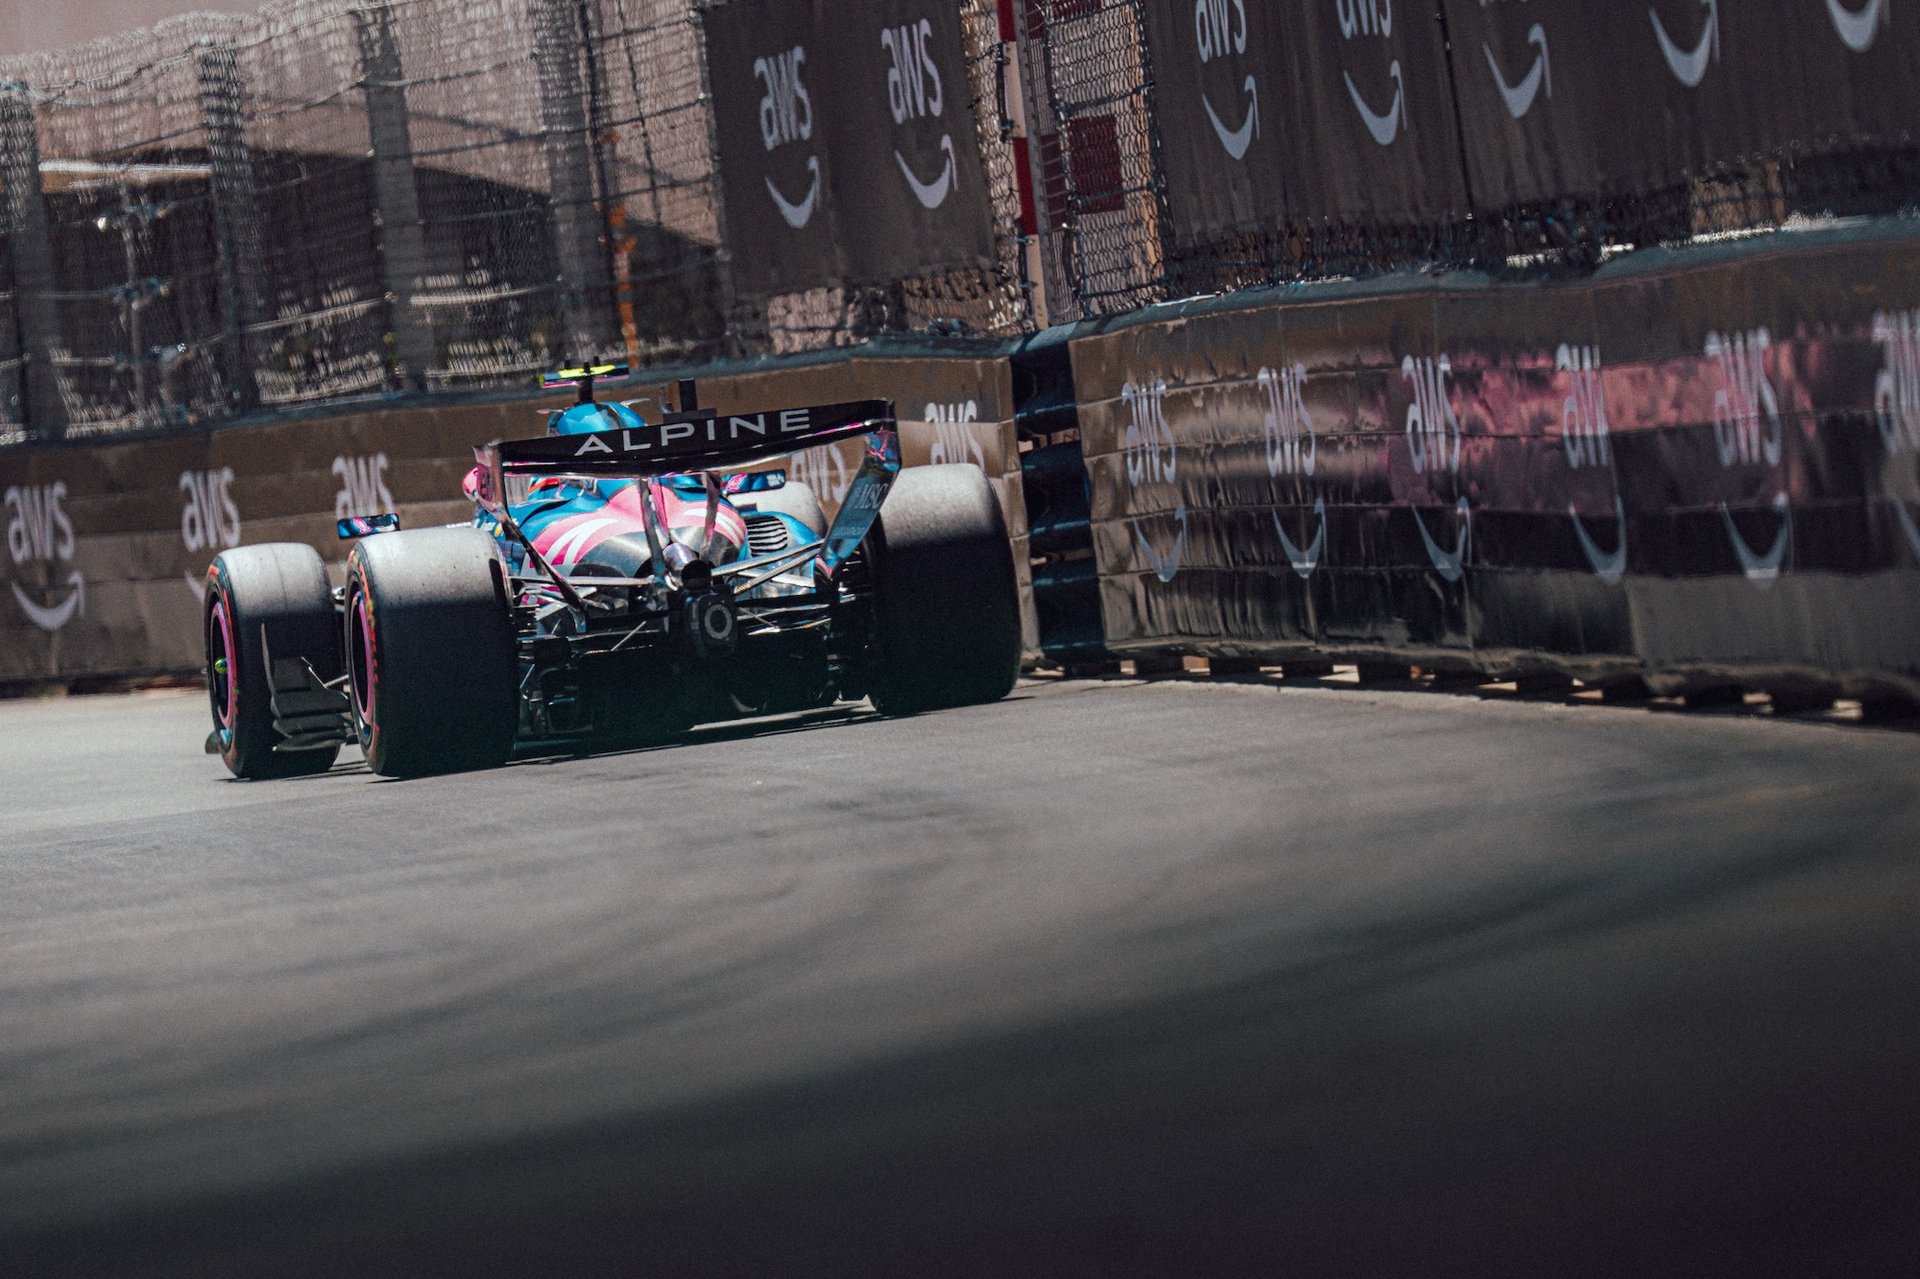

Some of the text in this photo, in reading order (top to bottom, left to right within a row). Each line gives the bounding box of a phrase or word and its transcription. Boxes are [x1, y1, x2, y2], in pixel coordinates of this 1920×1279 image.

[754, 45, 814, 150] aws
[881, 17, 943, 125] aws
[574, 409, 810, 456] ALPINE
[1121, 378, 1176, 486] aws
[1257, 362, 1317, 478] aws
[1401, 352, 1461, 474] aws
[1556, 342, 1608, 469] aw
[1704, 325, 1782, 468] aws
[1872, 308, 1920, 458] aw
[6, 480, 75, 564] aws
[179, 466, 242, 551] aws
[790, 442, 847, 504] ws
